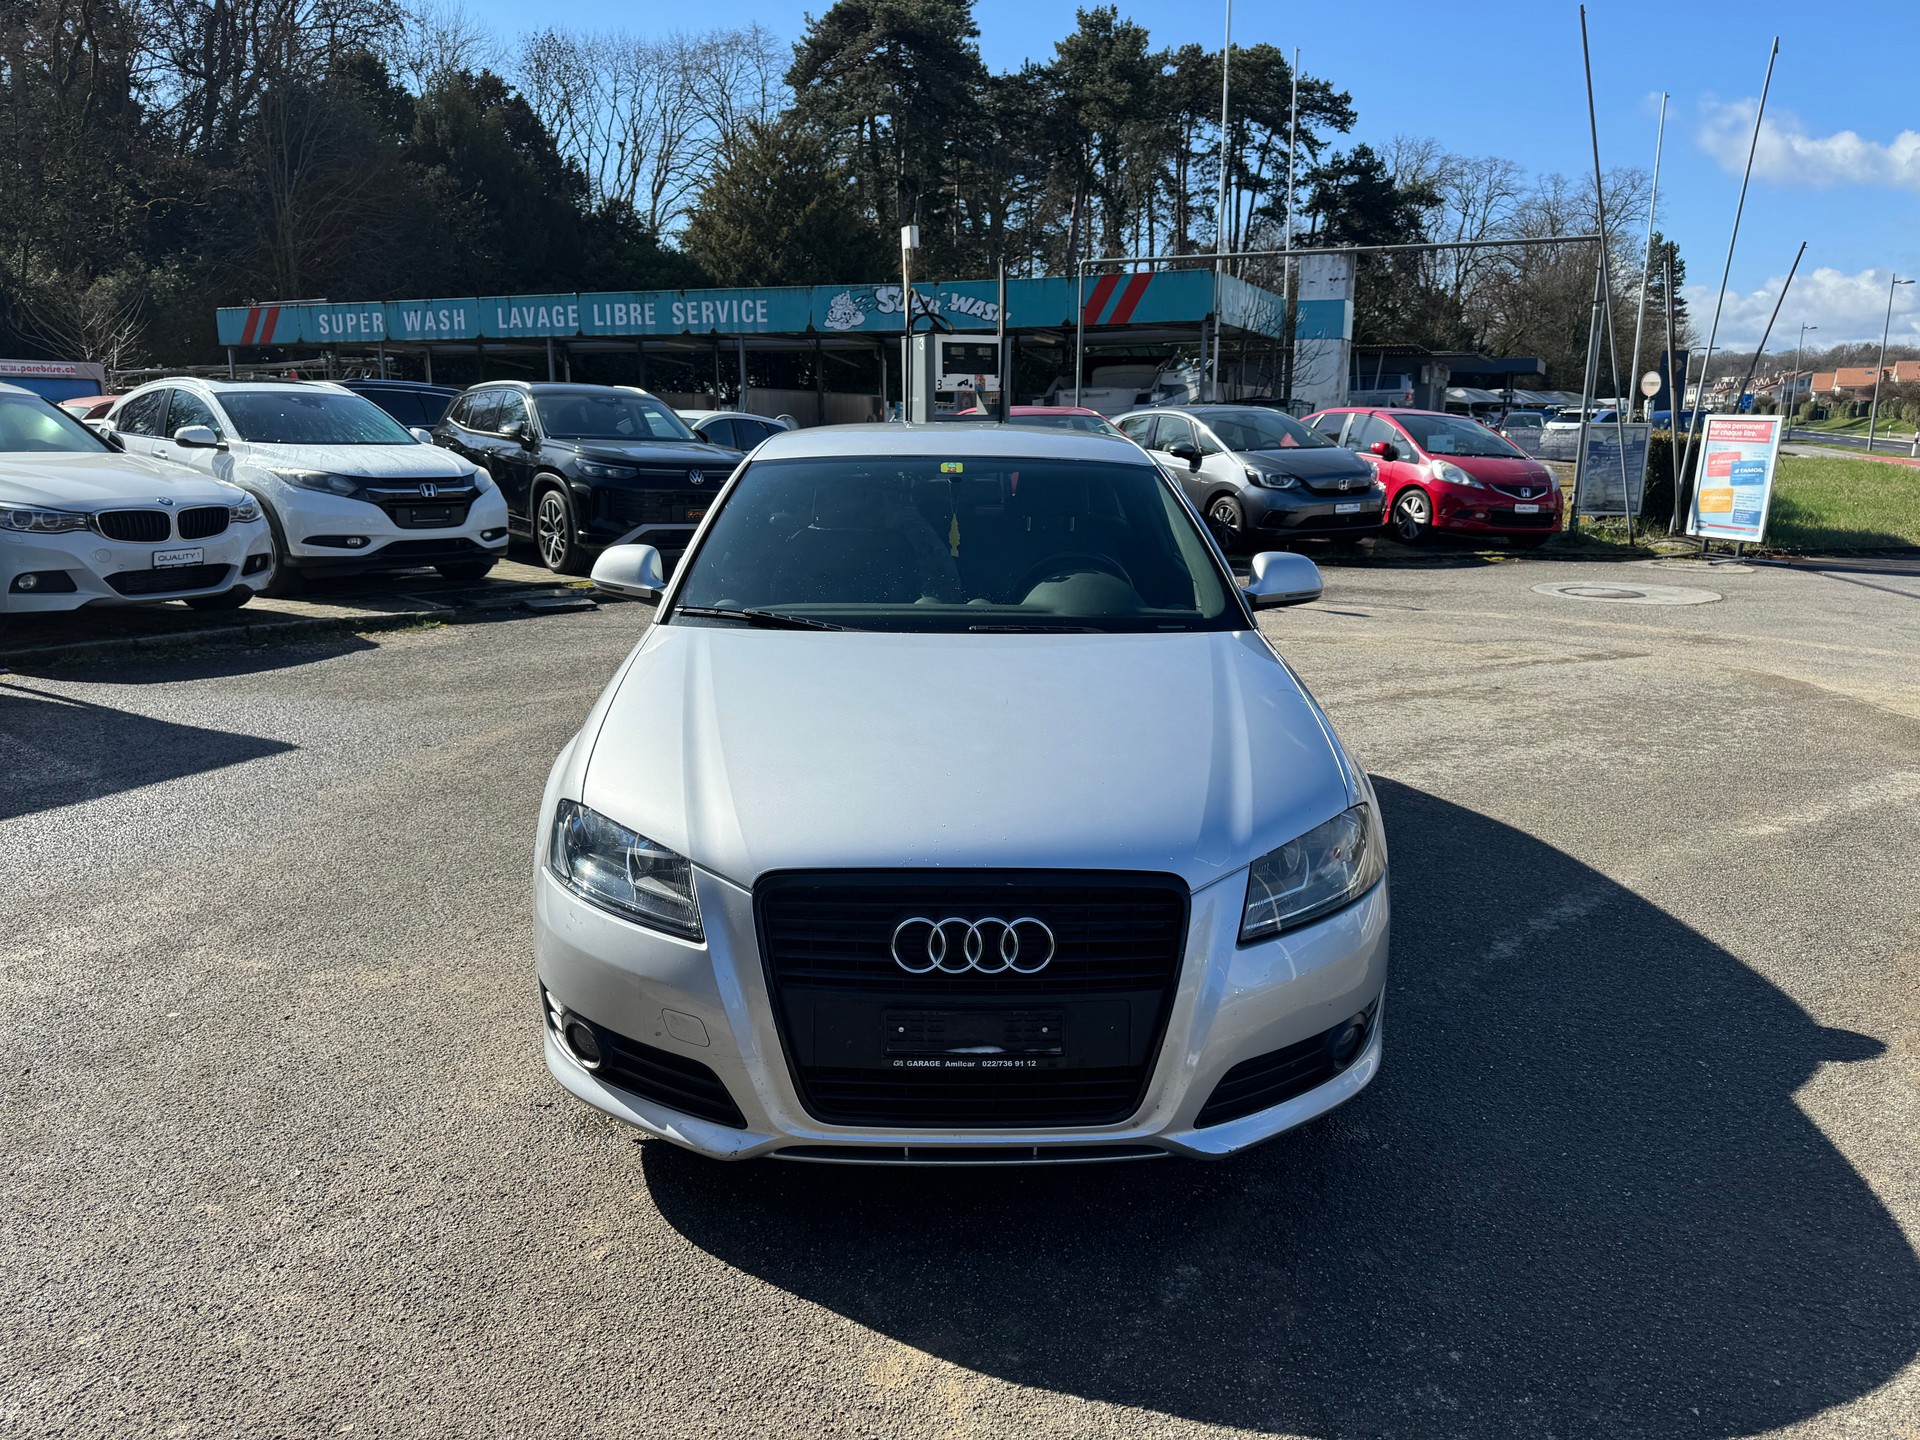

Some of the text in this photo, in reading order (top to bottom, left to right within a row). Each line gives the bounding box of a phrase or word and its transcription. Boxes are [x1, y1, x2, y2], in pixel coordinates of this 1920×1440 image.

[319, 299, 768, 334] SUPER WASH LAVAGE LIBRE SERVICE
[919, 338, 924, 350] 3
[937, 380, 942, 390] 3
[1720, 429, 1742, 437] chaque
[158, 553, 195, 561] QUALITY
